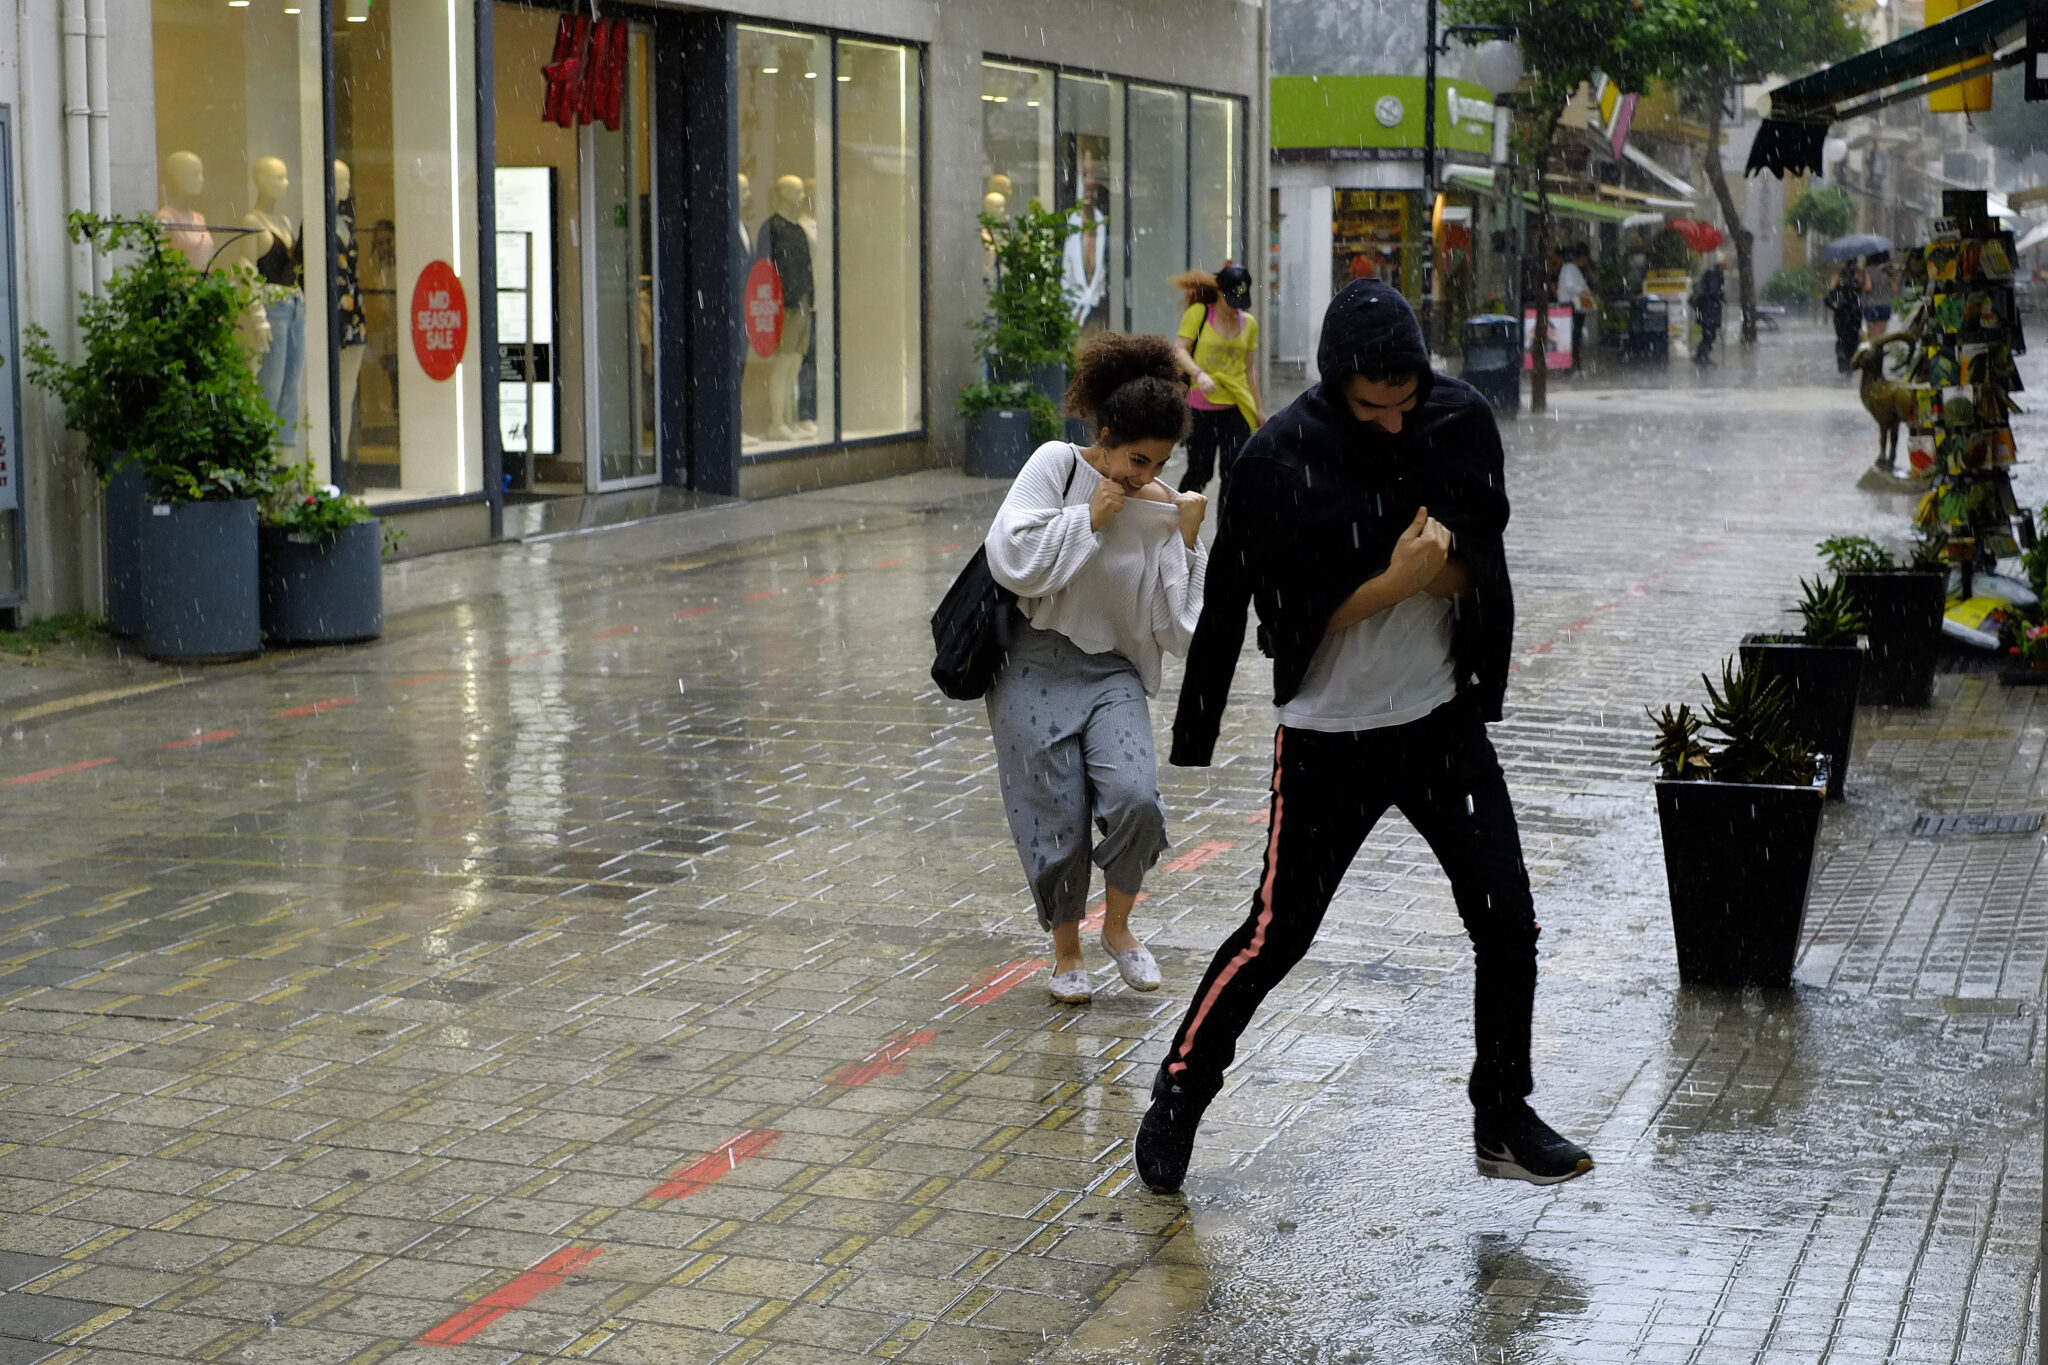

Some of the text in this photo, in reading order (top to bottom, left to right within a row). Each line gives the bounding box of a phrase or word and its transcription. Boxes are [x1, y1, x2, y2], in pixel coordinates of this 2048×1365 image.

[428, 290, 450, 309] MID
[418, 310, 461, 331] SEASON
[426, 330, 454, 350] SALE
